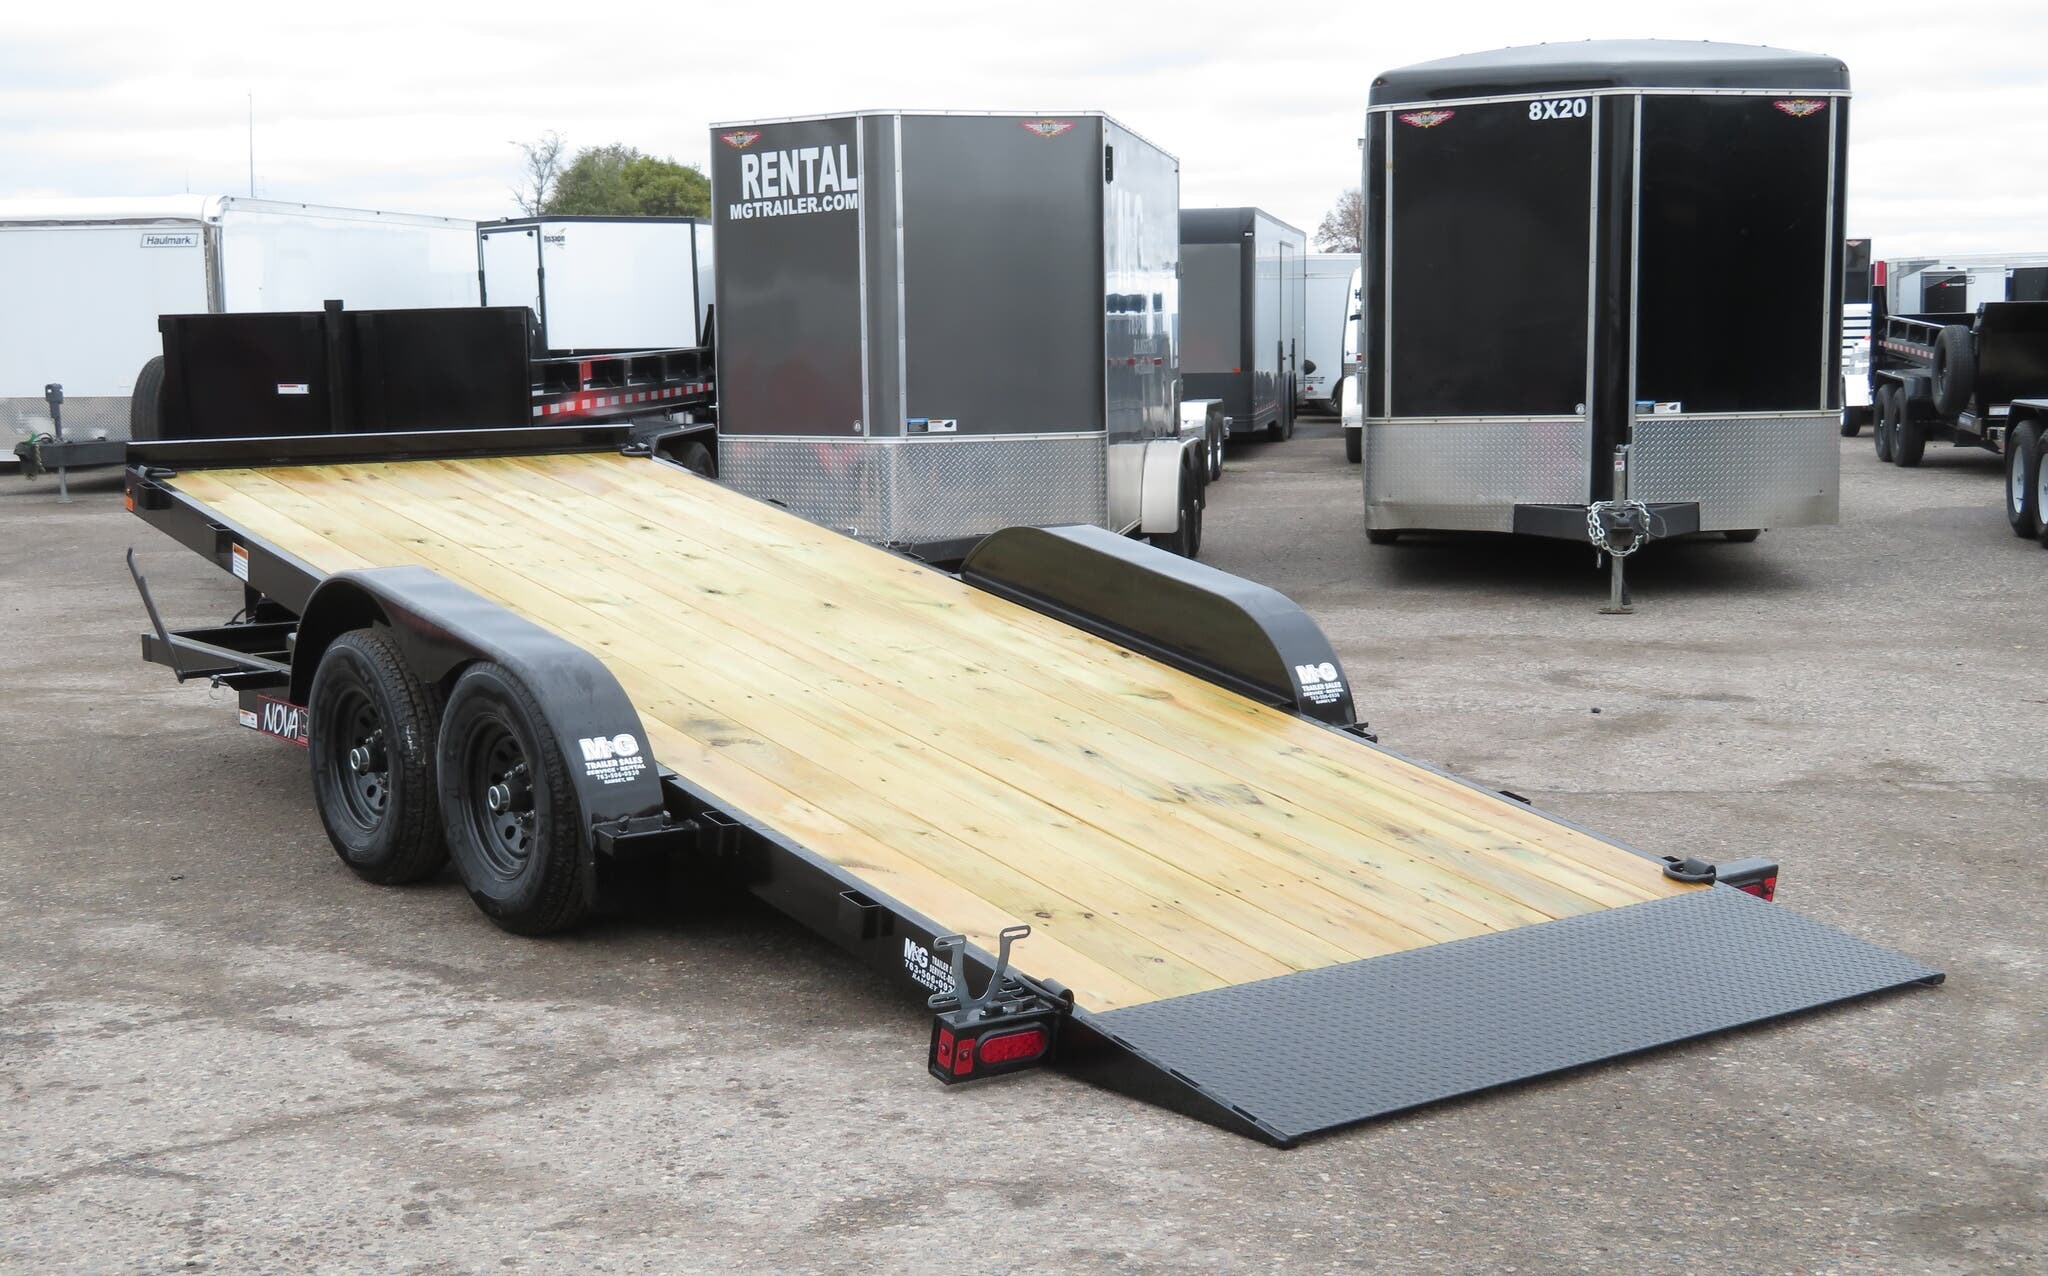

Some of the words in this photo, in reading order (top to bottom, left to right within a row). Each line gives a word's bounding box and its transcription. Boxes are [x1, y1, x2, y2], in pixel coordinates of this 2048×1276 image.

[1529, 98, 1587, 121] 8X20
[741, 144, 858, 200] RENTAL
[730, 193, 858, 220] MGTRAILER.COM
[146, 235, 193, 245] Haulmark
[263, 703, 299, 740] NOVA
[579, 733, 639, 761] M&G
[584, 759, 618, 770] TRAILER
[619, 756, 643, 766] SALES
[586, 767, 616, 776] SERVICE
[619, 763, 646, 772] RENTAL
[904, 937, 929, 968] M&G
[932, 955, 949, 973] TRAILER
[911, 972, 938, 992] RAMSEY
